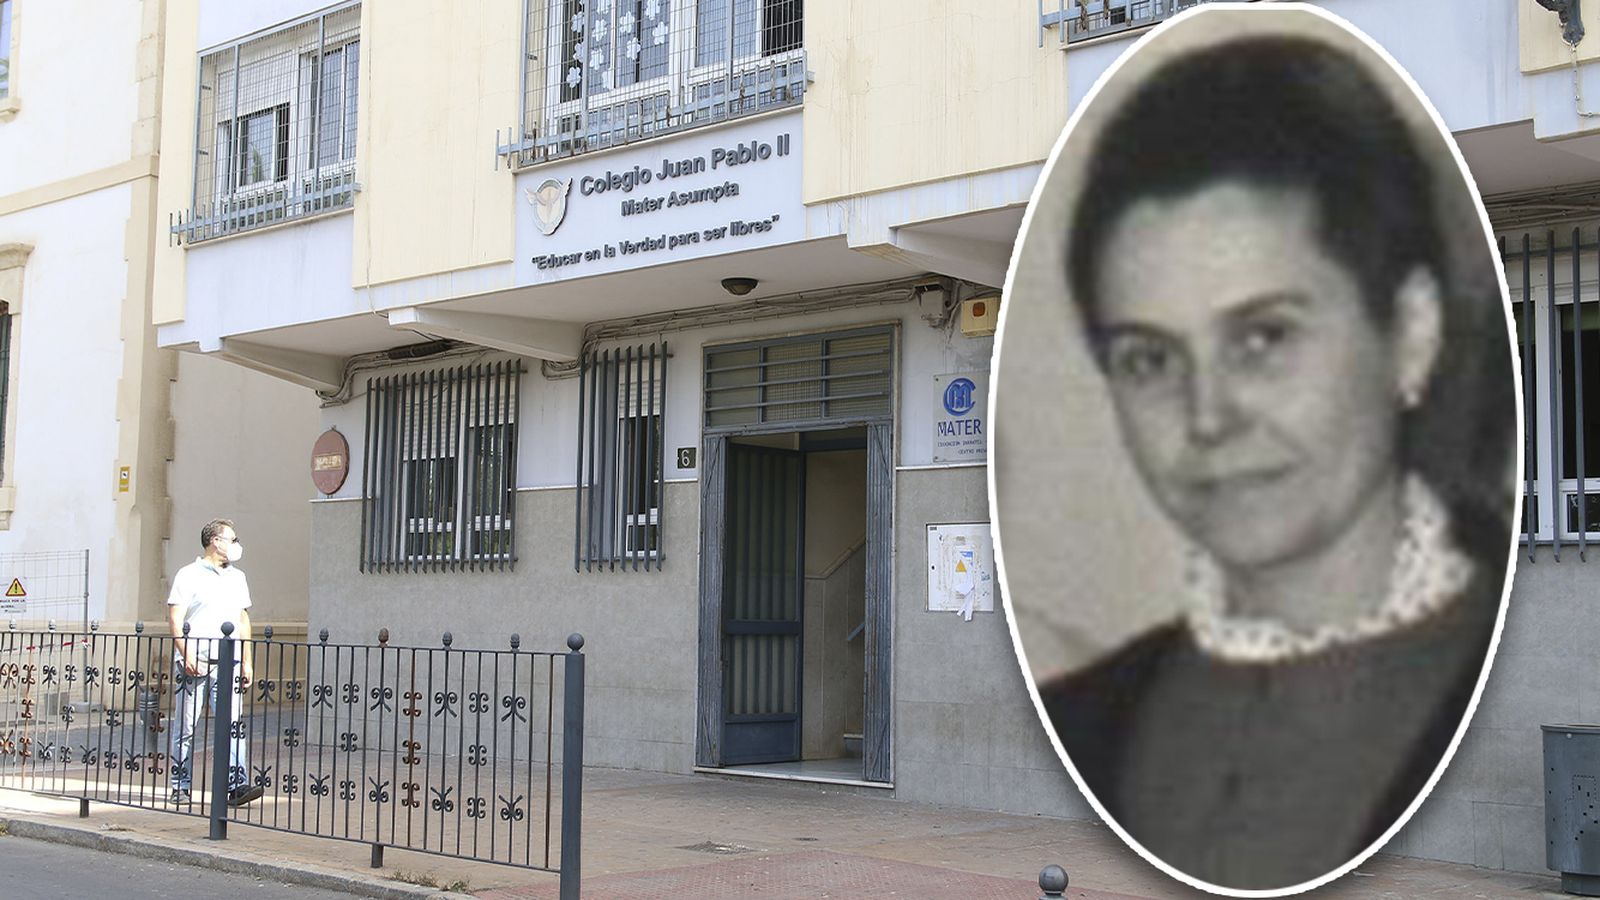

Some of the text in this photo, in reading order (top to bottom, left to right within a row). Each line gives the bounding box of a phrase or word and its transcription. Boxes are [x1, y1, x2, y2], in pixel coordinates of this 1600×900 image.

[580, 133, 790, 196] Colegio Juan Pablo II
[621, 181, 740, 216] Mater Asumpta
[584, 249, 600, 262] en
[604, 244, 616, 258] la
[619, 234, 666, 255] Verdad
[668, 231, 700, 250] para
[703, 226, 727, 241] ser
[937, 418, 982, 437] MATER
[681, 449, 690, 467] 6
